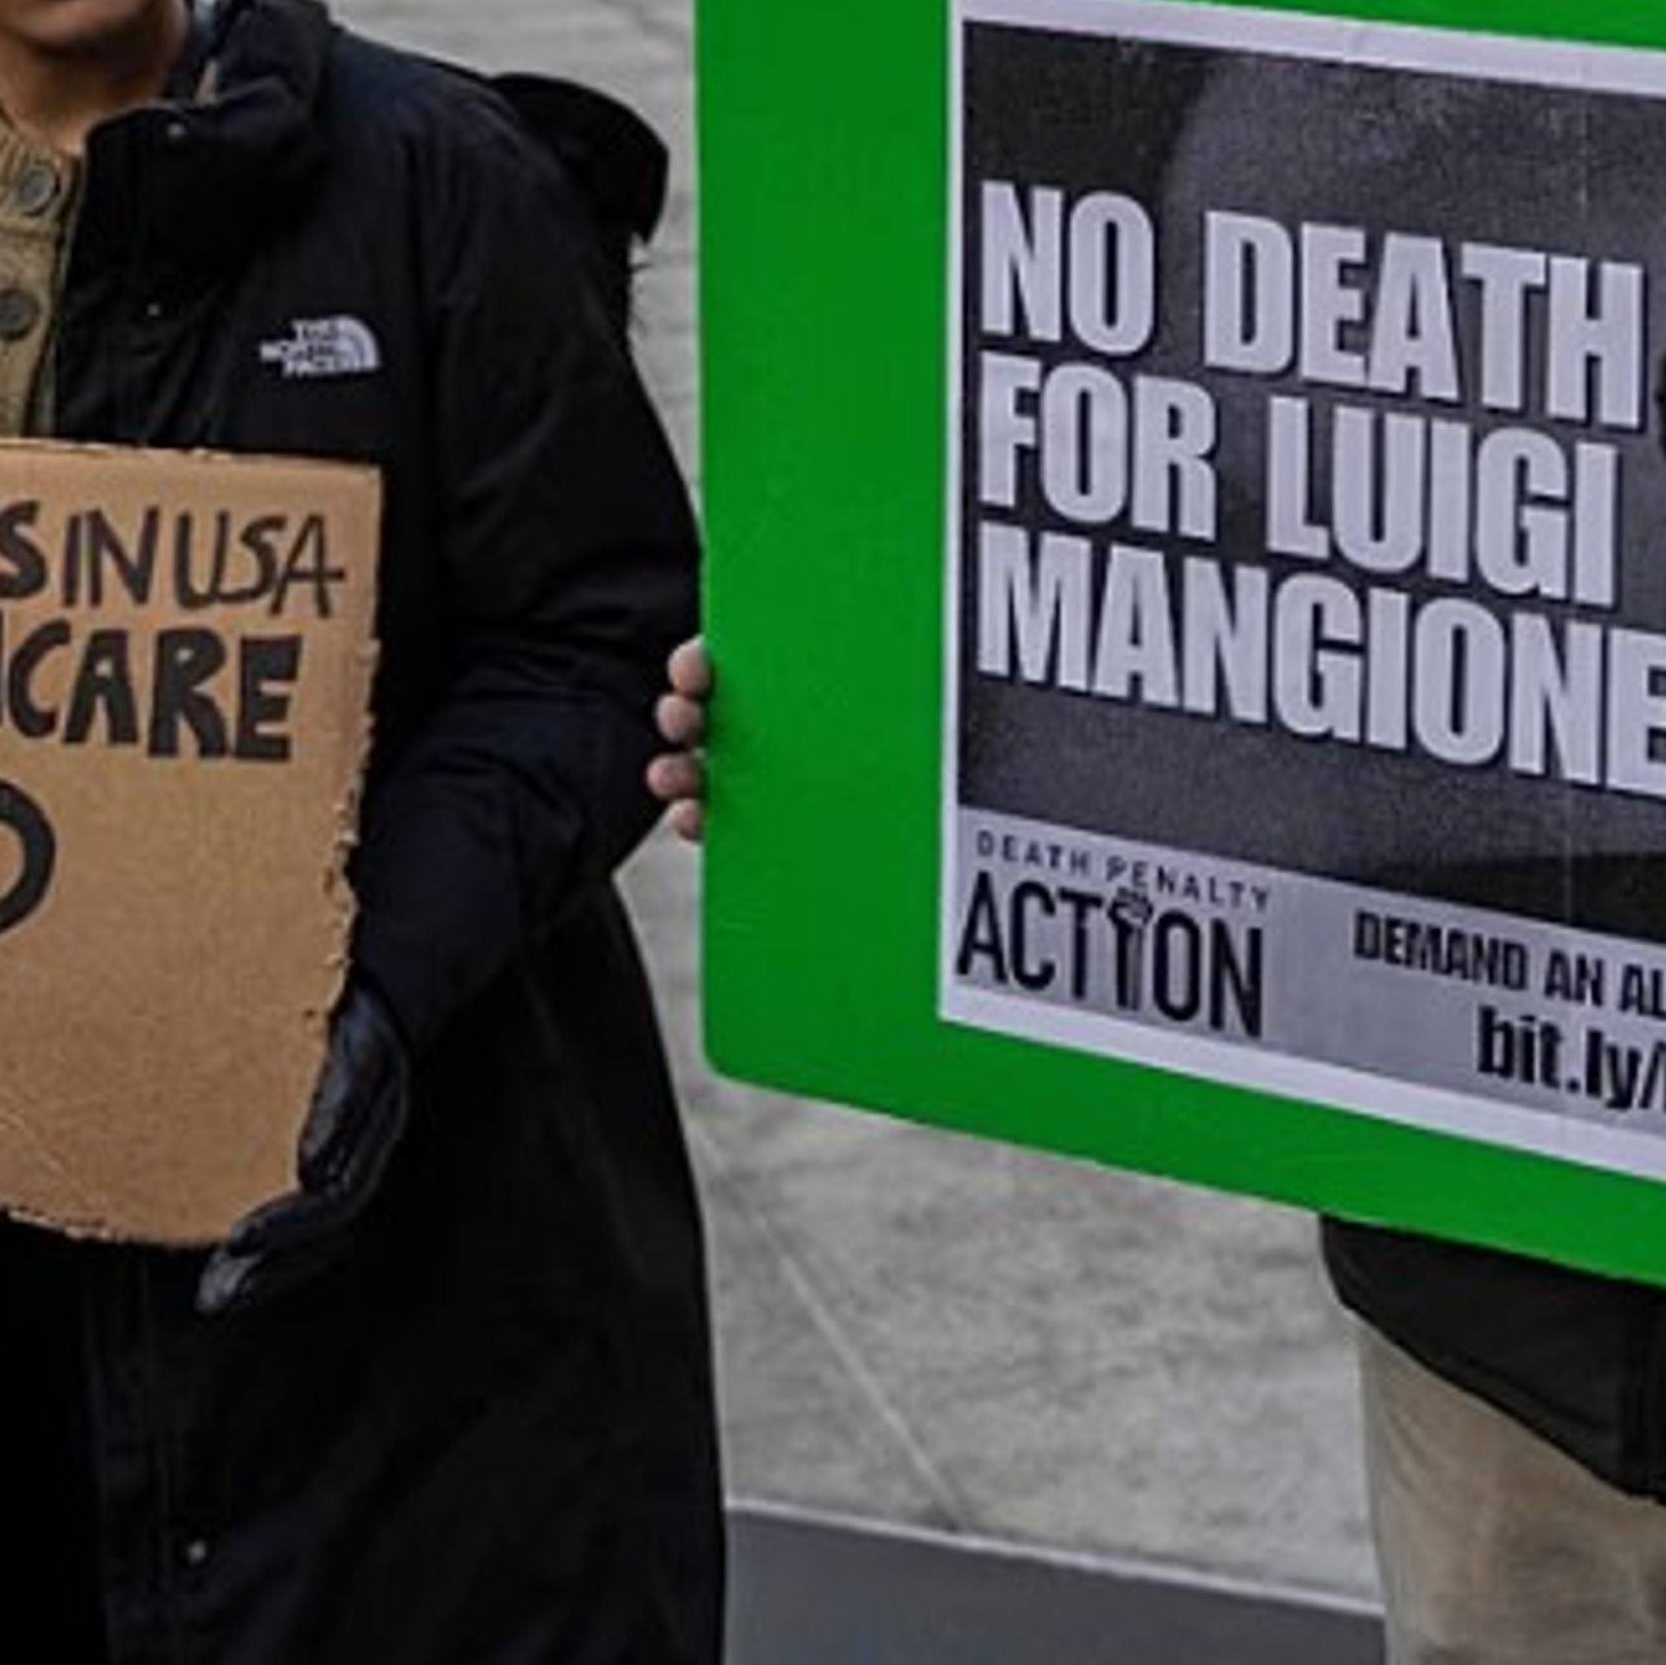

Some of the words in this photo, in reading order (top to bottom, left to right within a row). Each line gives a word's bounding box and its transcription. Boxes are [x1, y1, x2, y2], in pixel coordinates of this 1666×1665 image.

[981, 180, 1155, 355] NO
[1205, 210, 1643, 429] DEATH
[980, 351, 1218, 541] FOR
[1266, 395, 1619, 605] LUIGI
[63, 505, 160, 609] IN
[173, 508, 345, 619] USA
[976, 830, 1091, 877] DEATH
[1106, 855, 1271, 912] PENALTY
[955, 870, 1265, 1039] ACTION
[1353, 909, 1529, 993] DEMAND
[1543, 948, 1604, 1007] AN
